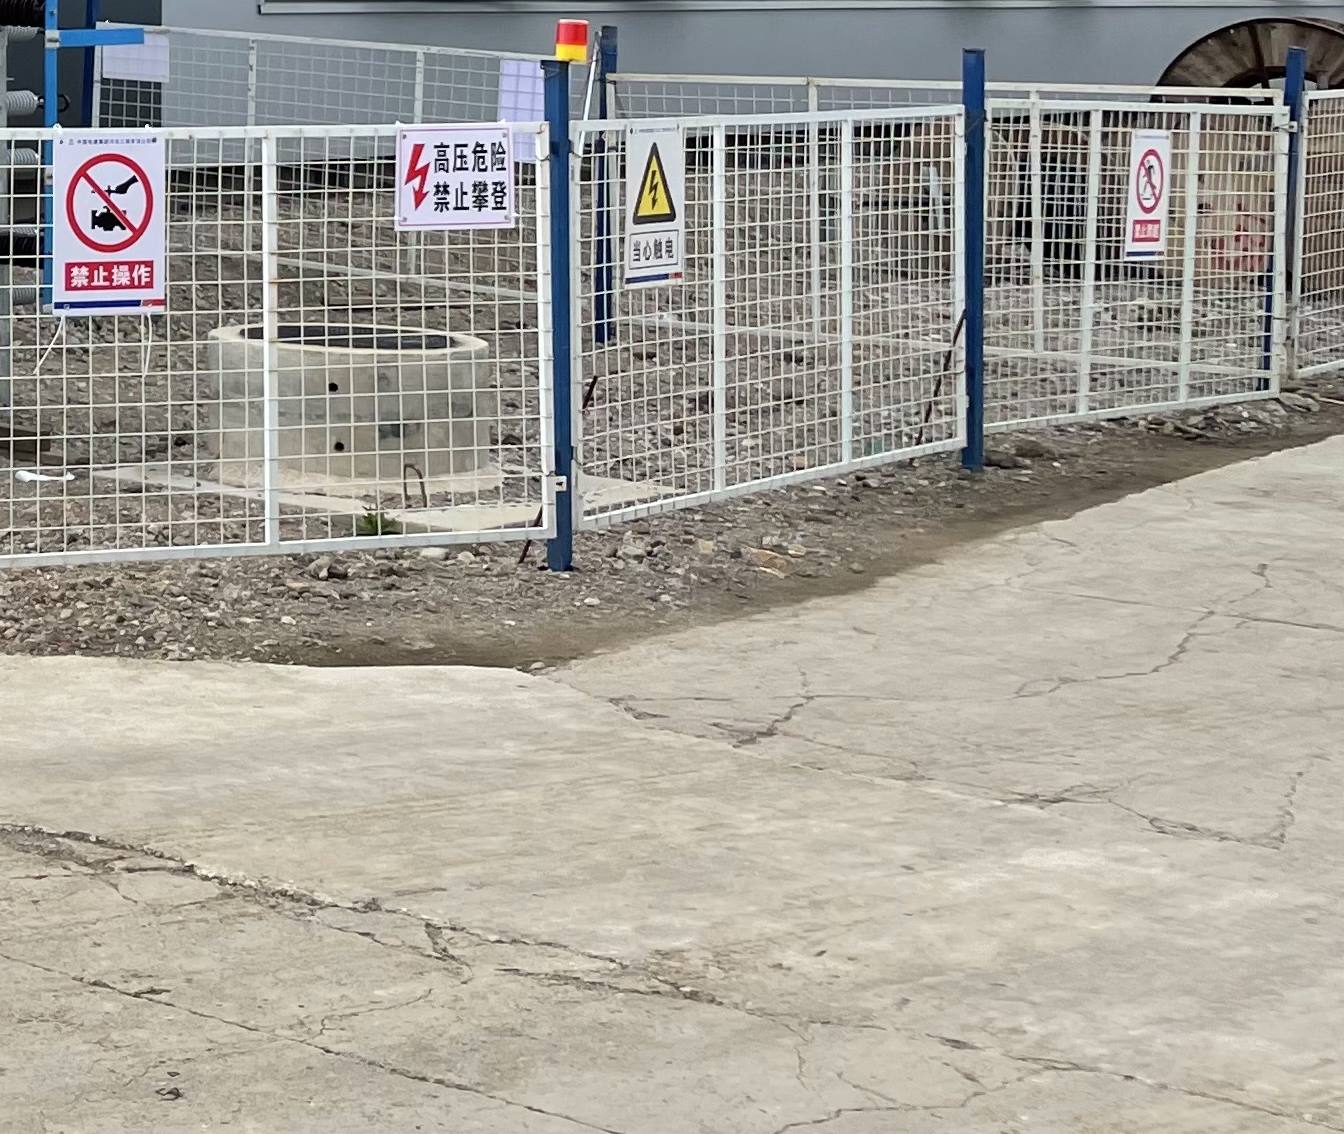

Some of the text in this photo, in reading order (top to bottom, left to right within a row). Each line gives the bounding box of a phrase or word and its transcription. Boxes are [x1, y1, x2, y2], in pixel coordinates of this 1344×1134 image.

[433, 141, 507, 173] 高压危险
[433, 181, 507, 212] 禁止攀登
[633, 237, 674, 262] 当心触电
[70, 264, 151, 287] 禁止操作
